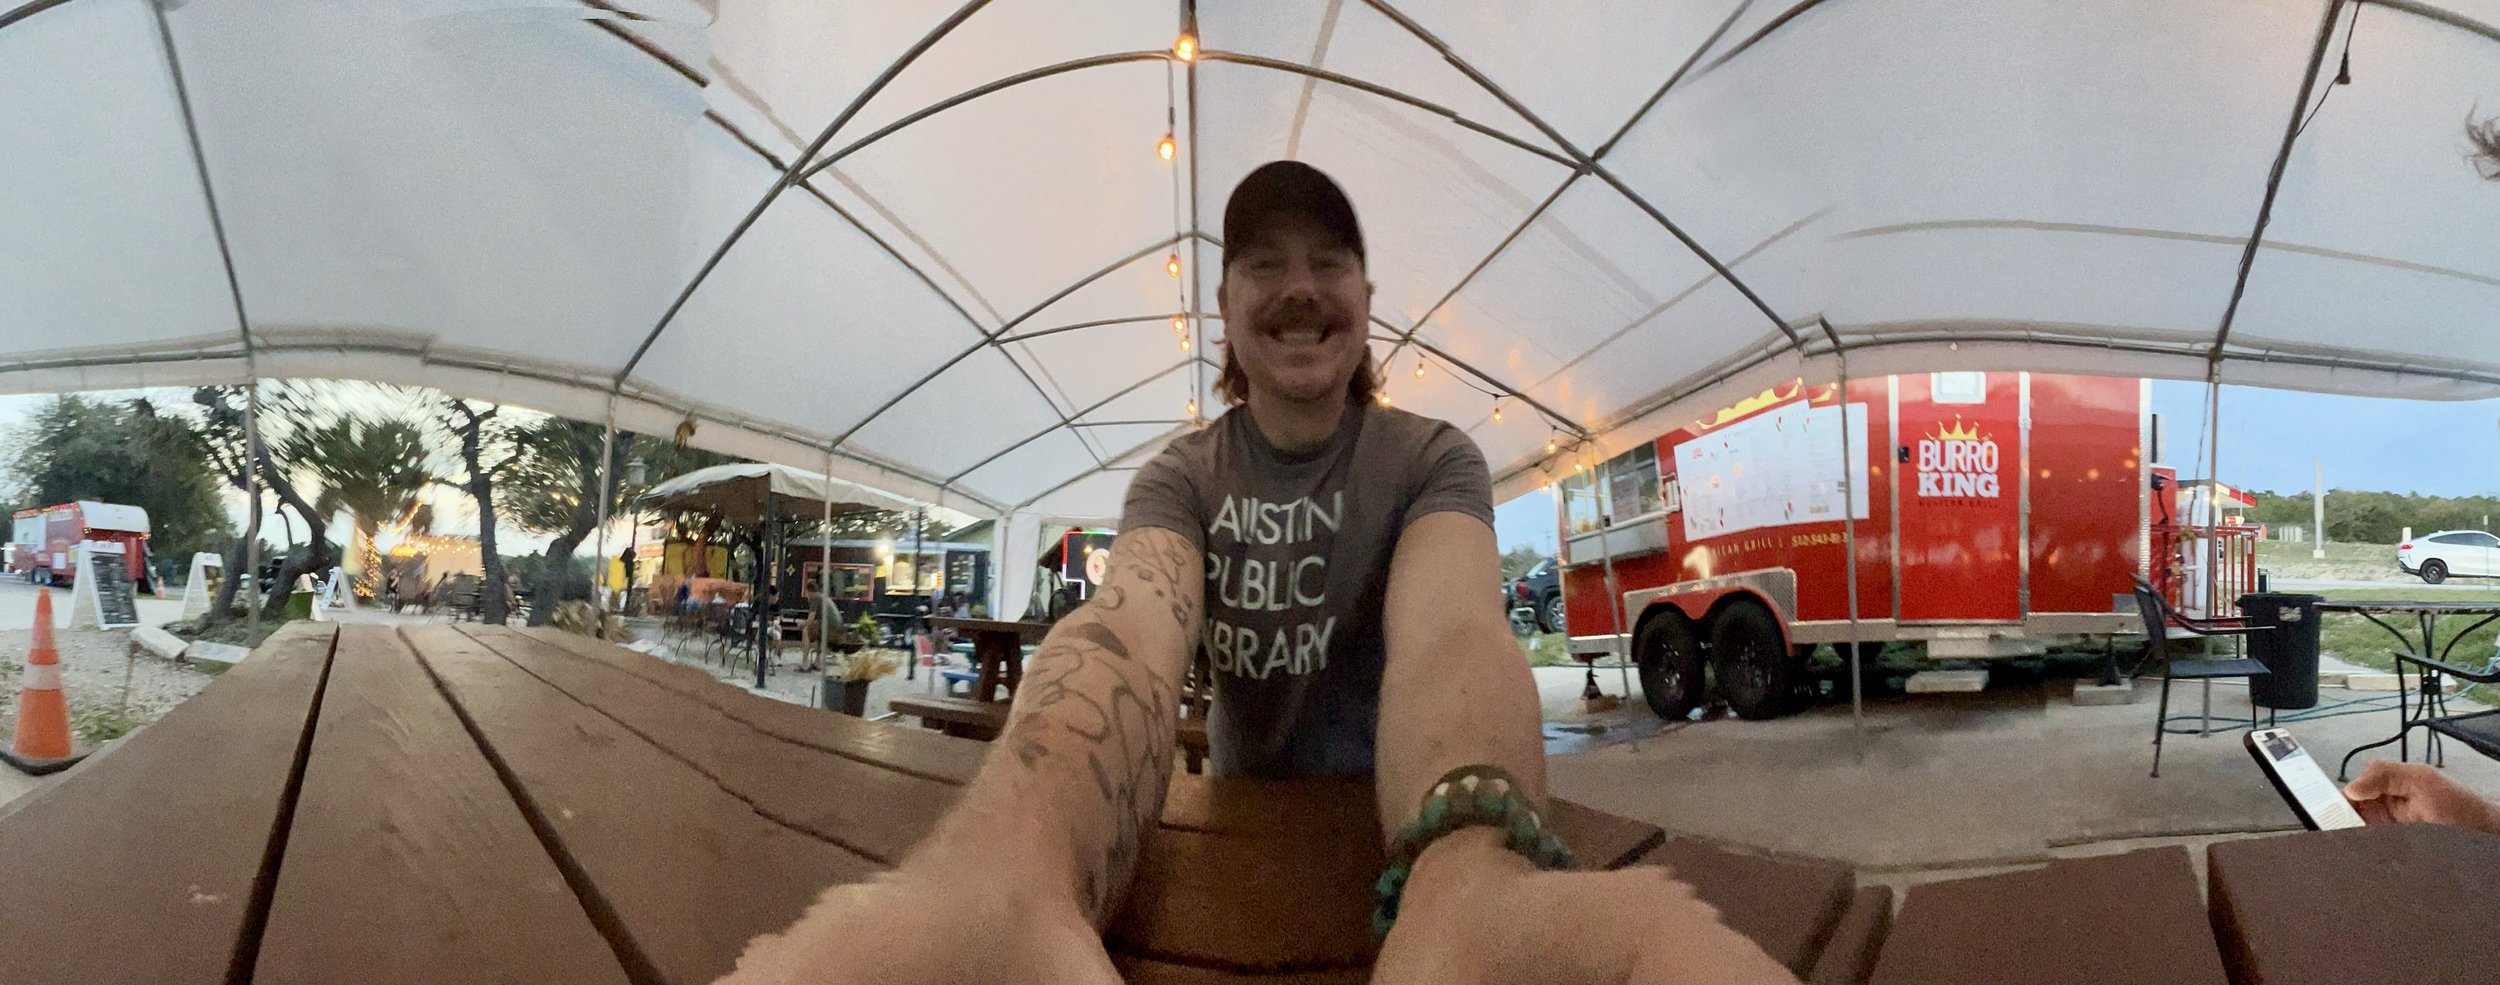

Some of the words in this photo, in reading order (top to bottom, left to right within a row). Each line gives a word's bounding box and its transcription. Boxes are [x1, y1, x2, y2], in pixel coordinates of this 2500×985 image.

[1919, 440, 1999, 473] BURRO
[1918, 472, 2000, 498] KING
[1208, 490, 1343, 545] AUSTIN
[1206, 551, 1326, 612] PUBLIC
